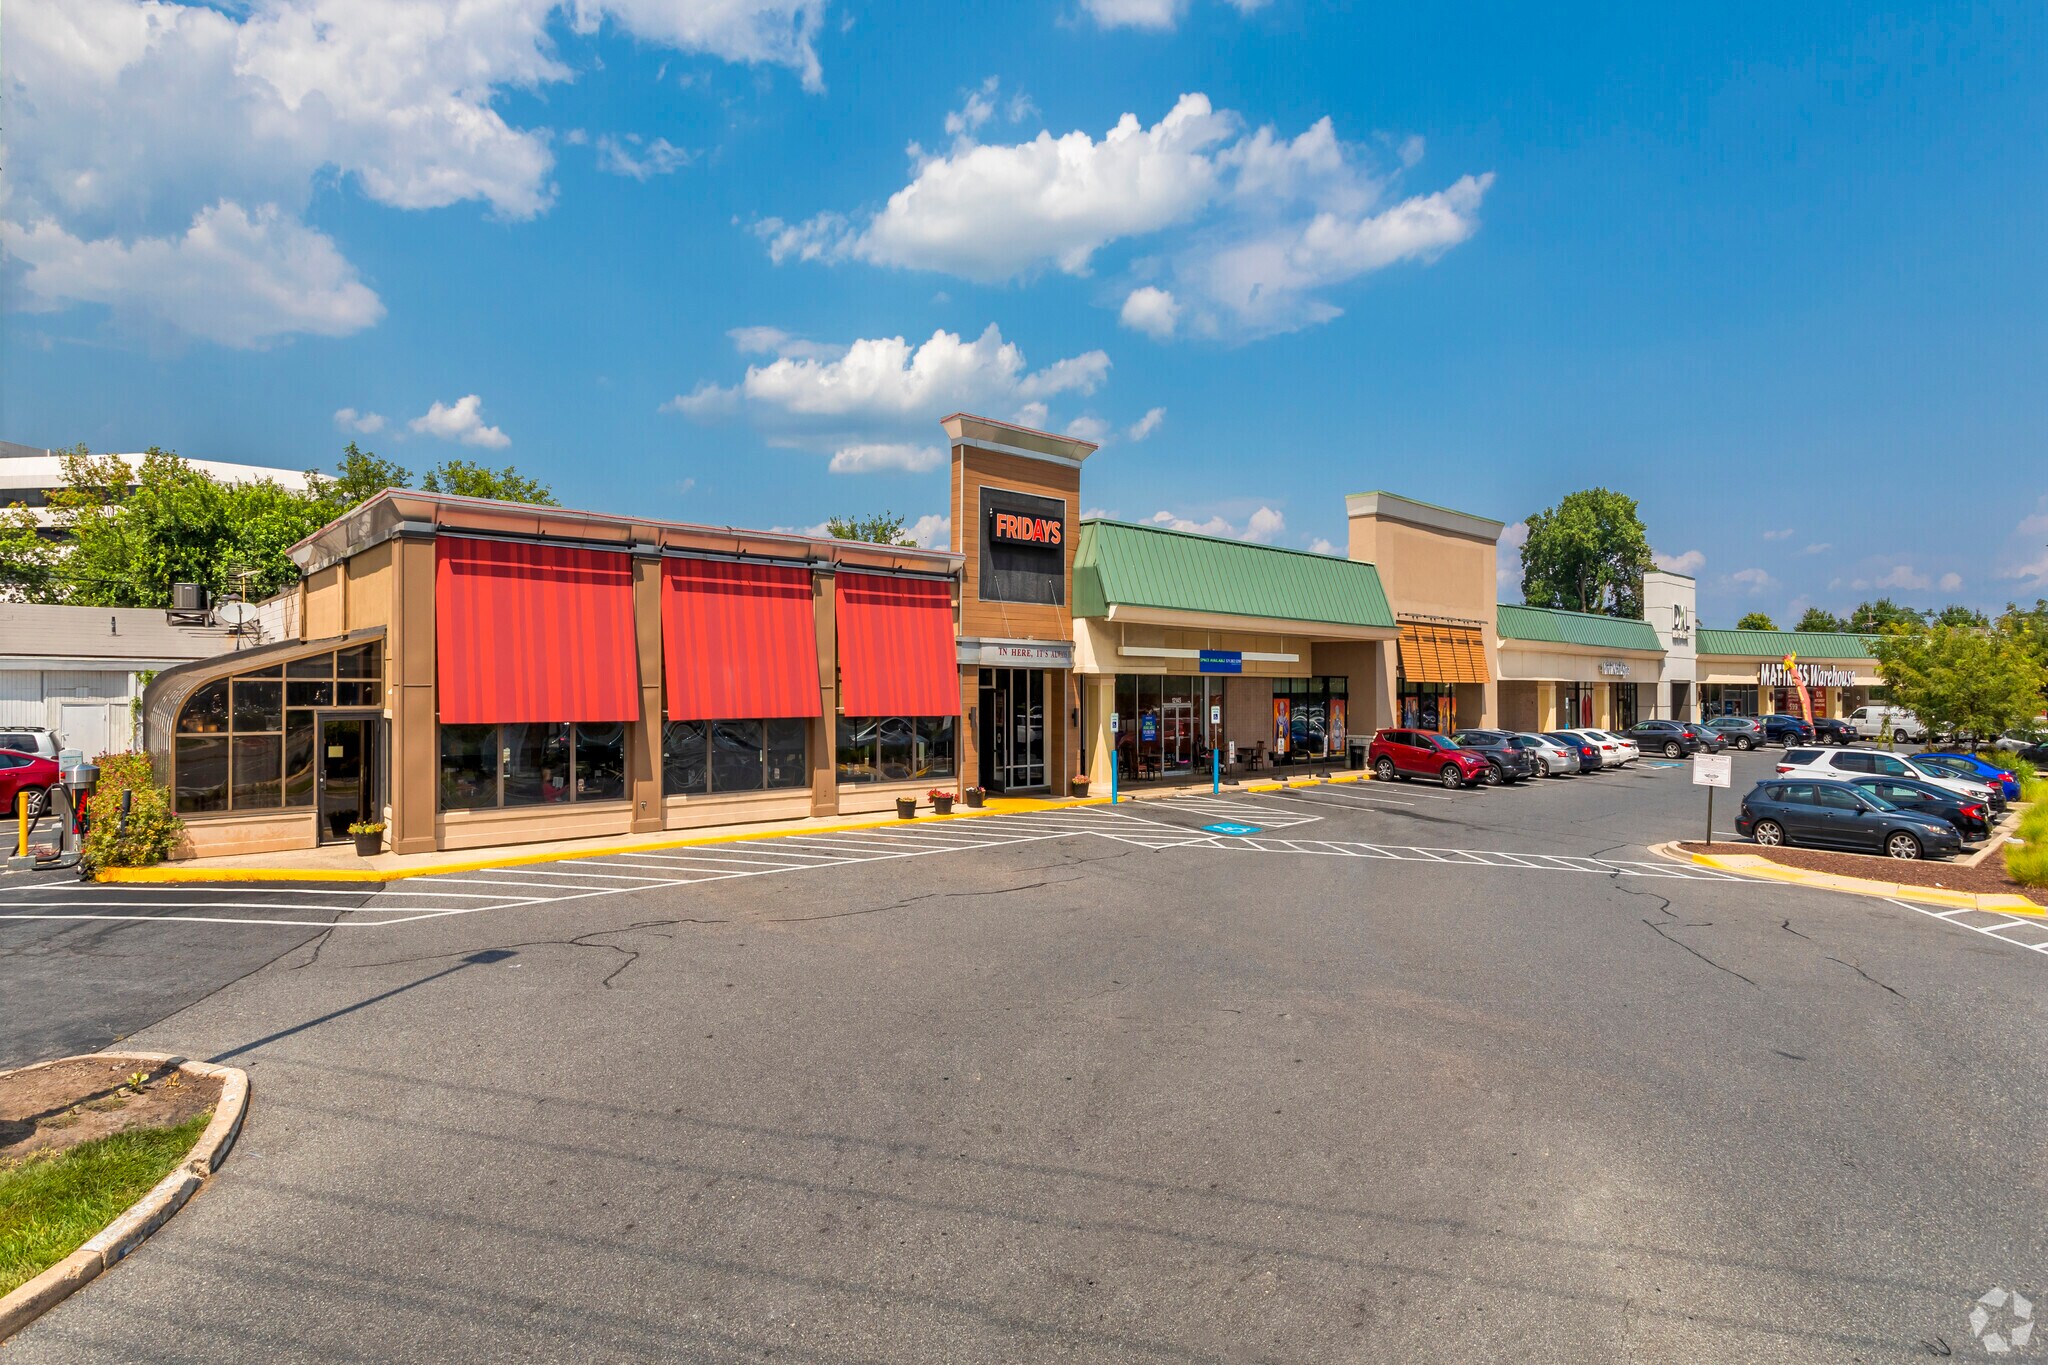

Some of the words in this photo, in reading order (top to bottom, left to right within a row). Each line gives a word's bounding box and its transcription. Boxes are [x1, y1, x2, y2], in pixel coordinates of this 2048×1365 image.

[996, 513, 1062, 545] FRIDAYS
[999, 647, 1008, 656] IN
[1011, 648, 1033, 658] HERE,
[1760, 663, 1810, 687] MATTRSS
[1810, 664, 1856, 687] Warehouse
